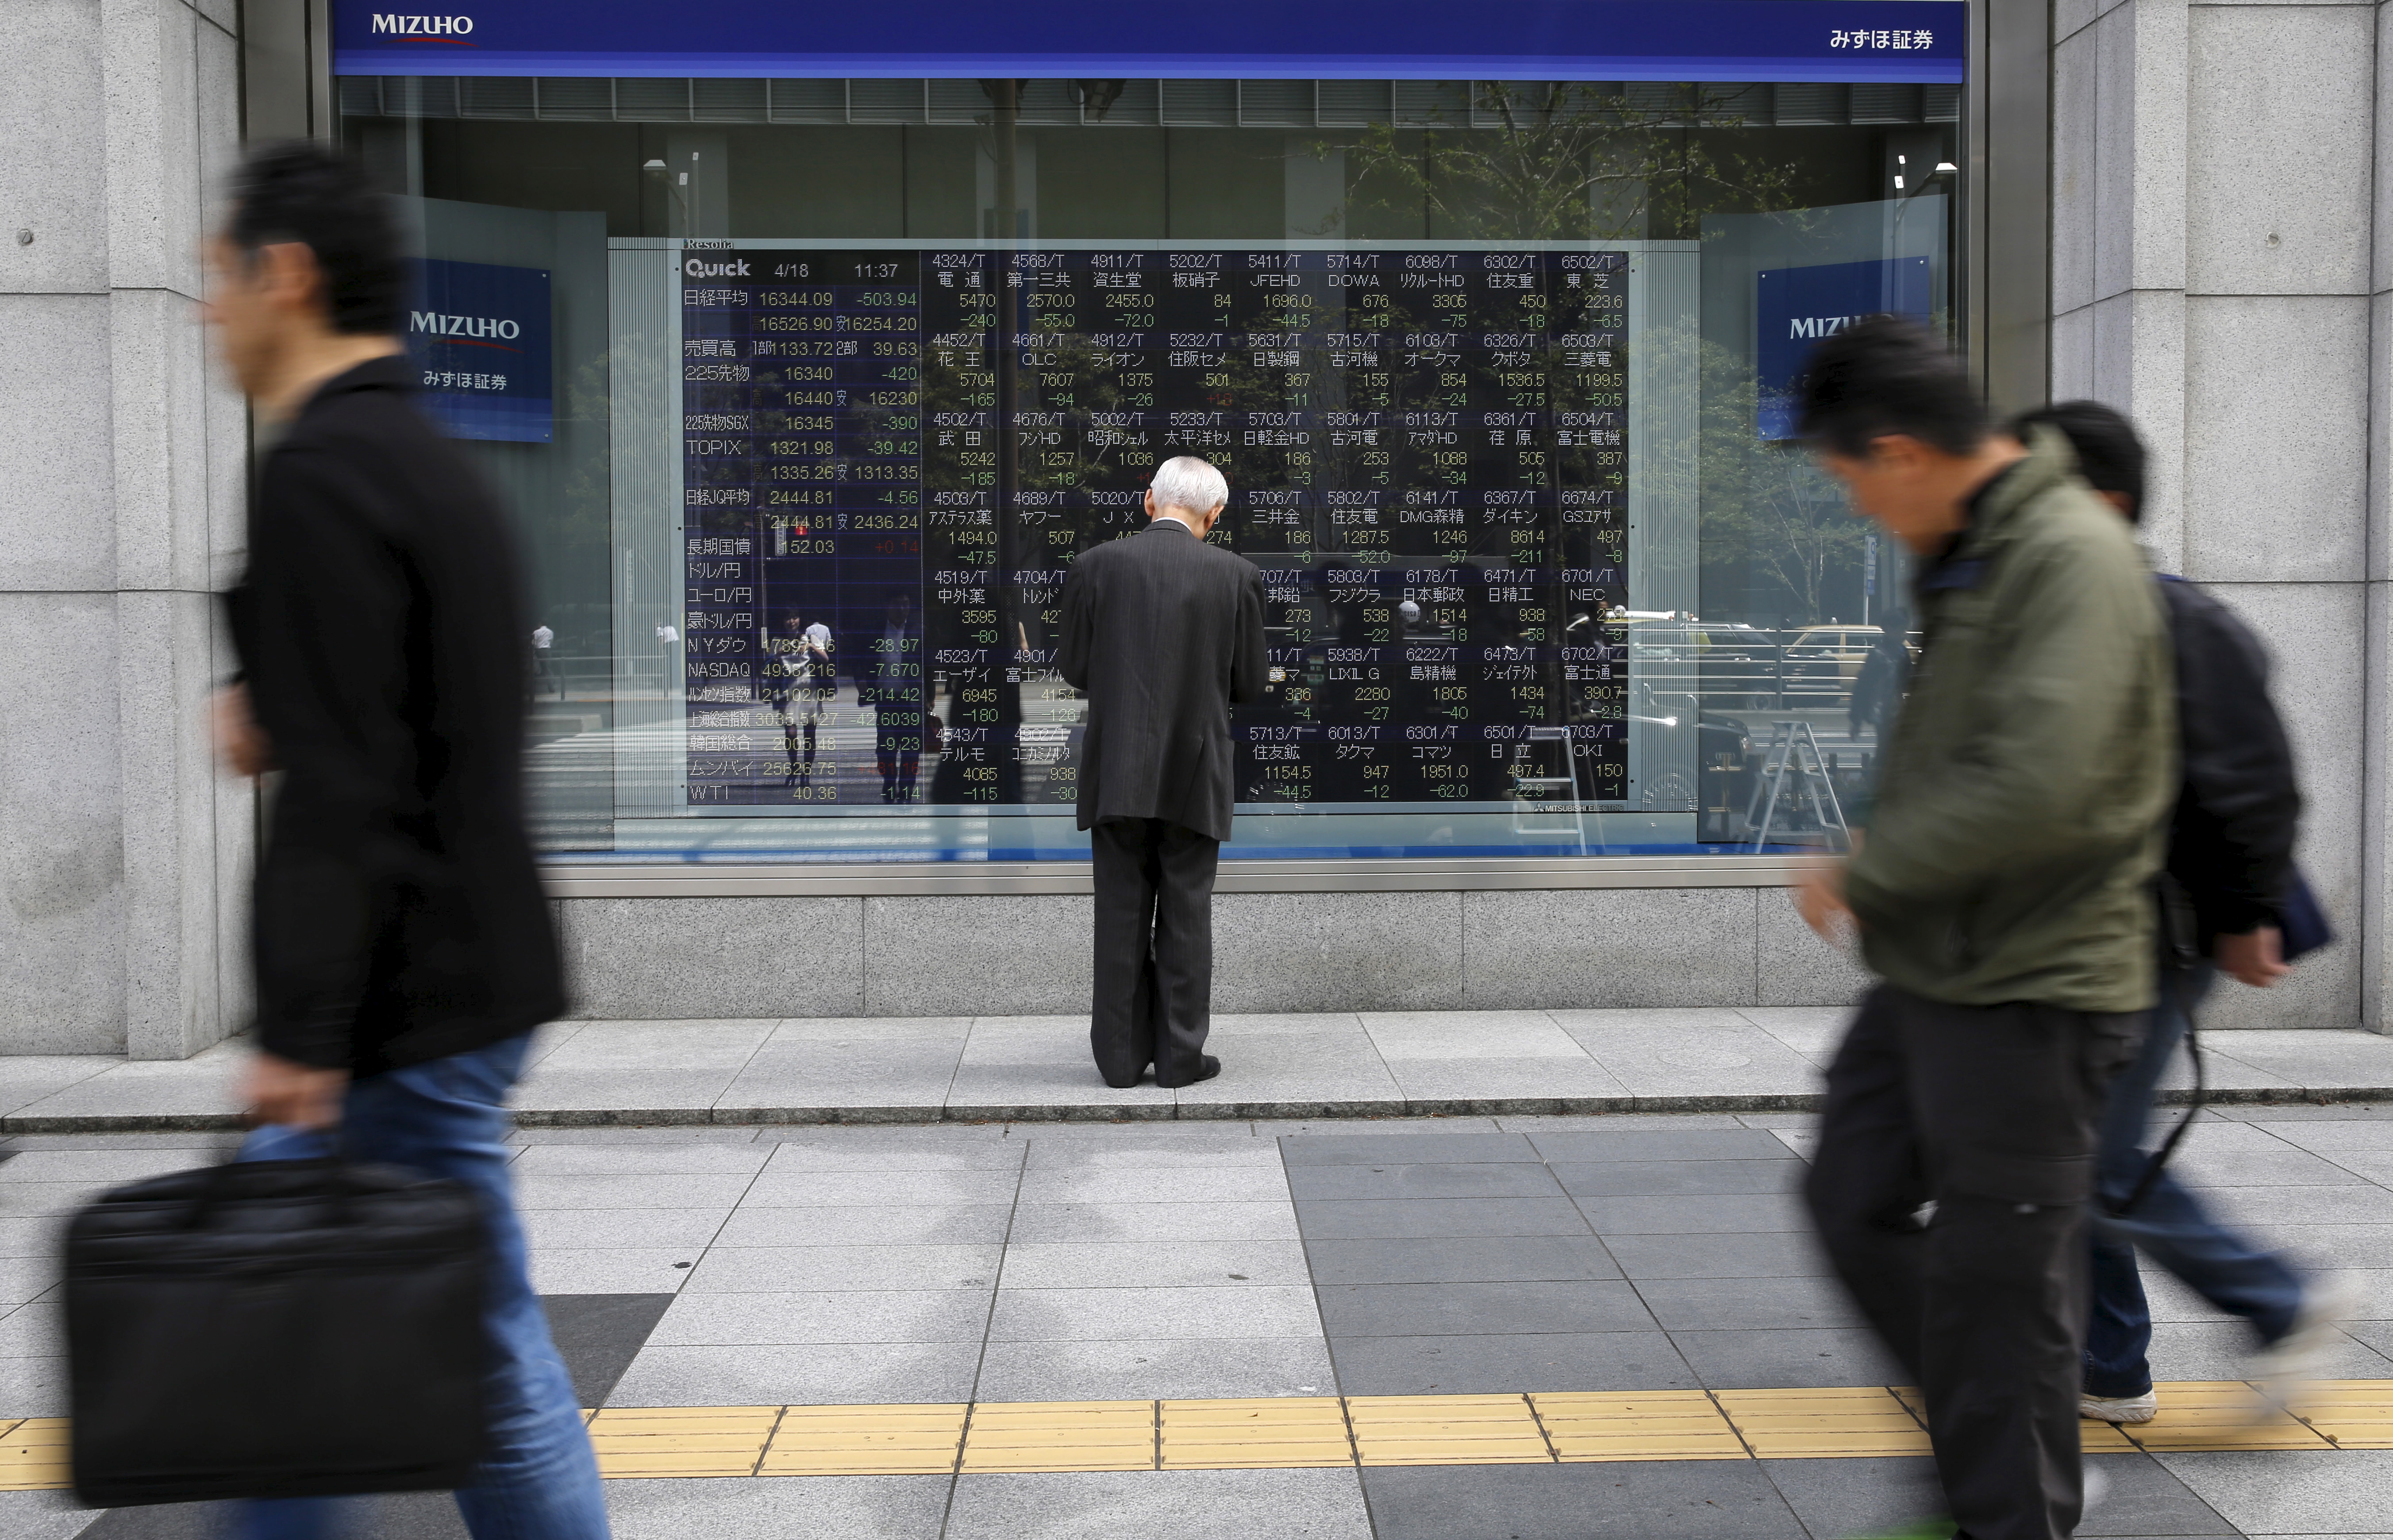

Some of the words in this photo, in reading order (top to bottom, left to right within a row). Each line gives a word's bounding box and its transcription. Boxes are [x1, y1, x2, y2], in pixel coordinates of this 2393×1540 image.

[372, 14, 473, 34] MIZUHO
[1830, 29, 1933, 49] みずほ証券
[688, 239, 734, 249] Resolia
[933, 254, 985, 267] 4324/T
[1012, 254, 1064, 267] 4568/T
[1091, 254, 1143, 267] 4911/T
[1170, 254, 1222, 267] 5202/T
[1249, 254, 1301, 267] 5411/T
[1327, 254, 1379, 267] 5714/T
[1406, 254, 1458, 268] 6098/T
[1484, 254, 1535, 268] 6302/T
[1562, 254, 1613, 268] 6502/T
[685, 259, 751, 278] Quick
[774, 264, 808, 277] 4/18
[855, 264, 898, 277] 11:37
[1007, 272, 1070, 288] 第一三共
[1093, 272, 1141, 288] 資生堂
[1173, 272, 1220, 288] 板硝子
[1250, 275, 1300, 286] JFEHD
[1329, 275, 1380, 286] DOWA
[1487, 273, 1533, 288] 住友重
[685, 289, 748, 306] 日経平均
[760, 293, 832, 306] 16344.09
[857, 293, 917, 306] -503.94
[960, 294, 996, 307] 5470
[1027, 294, 1074, 307] 2570.0
[1106, 294, 1154, 307] 2455.0
[1215, 294, 1231, 307] 84
[1264, 294, 1311, 307] 1696.0
[1363, 294, 1388, 307] 676
[1433, 295, 1466, 308] 3305
[1520, 295, 1546, 308] 450
[1585, 295, 1622, 308] 223.6
[410, 311, 519, 339] MIZUHO
[760, 317, 832, 331] 16526.90
[837, 315, 846, 331] 安
[845, 317, 917, 331] 16254.20
[961, 314, 996, 327] -240
[1036, 314, 1074, 327] -55.0
[1115, 314, 1154, 327] -72.0
[1215, 314, 1227, 327] -1
[1273, 314, 1310, 327] -44.5
[1363, 314, 1388, 327] -18
[1442, 315, 1466, 327] -75
[1520, 315, 1544, 327] -18
[1594, 315, 1622, 327] -6.5
[685, 340, 736, 356] 売買高
[873, 342, 917, 355] 39.63
[685, 365, 749, 381] 225先物
[785, 367, 832, 380] 16340
[882, 367, 917, 380] -420
[423, 371, 507, 390] みずほ証券
[785, 392, 832, 405] 16440
[837, 390, 846, 406] 安
[870, 392, 917, 405] 16230
[686, 414, 749, 431] 225先物SGX
[786, 417, 833, 430] 16345
[882, 417, 917, 430] -390
[686, 440, 741, 454] TOPIX
[771, 442, 833, 454] 1321.98
[868, 442, 918, 454] -39.42
[771, 466, 834, 479] 1335.26
[838, 464, 847, 481] 安
[855, 466, 918, 479] 1313.35
[687, 489, 749, 505] 日経JQ平均
[770, 491, 832, 504] 2444.81
[878, 491, 918, 504] -4.56
[934, 491, 986, 505] 4503/T
[1013, 491, 1066, 505] 4689/T
[1092, 491, 1144, 505] 5020/T
[1250, 491, 1301, 504] 5706/T
[1328, 491, 1380, 504] 5802/T
[1406, 490, 1458, 504] 6141/T
[1484, 490, 1535, 504] 6367/T
[1562, 490, 1613, 504] 6674/T
[770, 516, 832, 529] 2444.81
[838, 513, 847, 530] 安
[855, 516, 918, 529] 2436.24
[1020, 509, 1061, 525] ヤフー
[1252, 509, 1300, 524] 三井金
[1331, 509, 1378, 524] 住友電
[1400, 508, 1464, 524] DMG森精
[1483, 508, 1537, 524] ダイキン
[950, 531, 996, 544] 1494.0
[1049, 531, 1074, 544] 507
[1207, 531, 1231, 544] 274
[1285, 531, 1310, 544] 186
[1343, 531, 1389, 544] 1287.5
[1433, 531, 1467, 543] 1246
[1512, 531, 1544, 543] 8614
[1597, 531, 1622, 543] 497
[687, 538, 750, 556] 長期国債
[781, 540, 834, 554] 152.03
[875, 541, 918, 554] +0.14
[958, 551, 996, 564] -47.5
[1058, 551, 1074, 564] -6
[1294, 551, 1310, 564] -6
[1352, 551, 1390, 564] -52.0
[1443, 551, 1467, 563] -97
[1512, 551, 1542, 563] -211
[1606, 551, 1622, 563] -8
[689, 562, 740, 578] ドル/円
[688, 588, 751, 603] ユーロ/円
[869, 639, 919, 652] -28.97
[689, 662, 750, 677] NASDAQ
[869, 664, 919, 677] -7.670
[762, 689, 836, 702] 21102.05
[860, 689, 919, 701] -214.42
[850, 713, 920, 726] -42.6039
[936, 728, 988, 741] 4543/T
[1250, 726, 1302, 739] 5713/T
[1328, 726, 1380, 739] 6013/T
[1406, 725, 1458, 739] 6301/T
[1484, 725, 1535, 739] 6501/T
[1562, 725, 1613, 739] 6703/T
[690, 735, 753, 751] 韓国総合
[773, 738, 836, 751] 2005.48
[880, 738, 920, 751] -9.23
[940, 747, 985, 761] テルモ
[1253, 744, 1300, 759] 住友鉱
[1336, 744, 1374, 759] タクマ
[1413, 745, 1451, 758] コマツ
[1574, 744, 1603, 757] OKI
[690, 760, 753, 776] ムンバイ
[763, 762, 836, 775] 25626.75
[963, 767, 997, 781] 4085
[1050, 767, 1076, 781] 938
[1265, 766, 1311, 779] 1154.5
[1364, 766, 1389, 779] 947
[1421, 765, 1468, 778] 1951.0
[1507, 765, 1544, 778] 497.4
[1597, 764, 1622, 777] 150
[794, 787, 836, 800] 40.36
[880, 787, 920, 800] -1.14
[964, 787, 997, 800] -115
[1051, 787, 1077, 800] -30
[1274, 785, 1311, 798] -44.5
[1364, 785, 1389, 798] -12
[1430, 785, 1468, 797] -62.0
[1507, 784, 1544, 797] -22.9
[1605, 784, 1618, 797] -1
